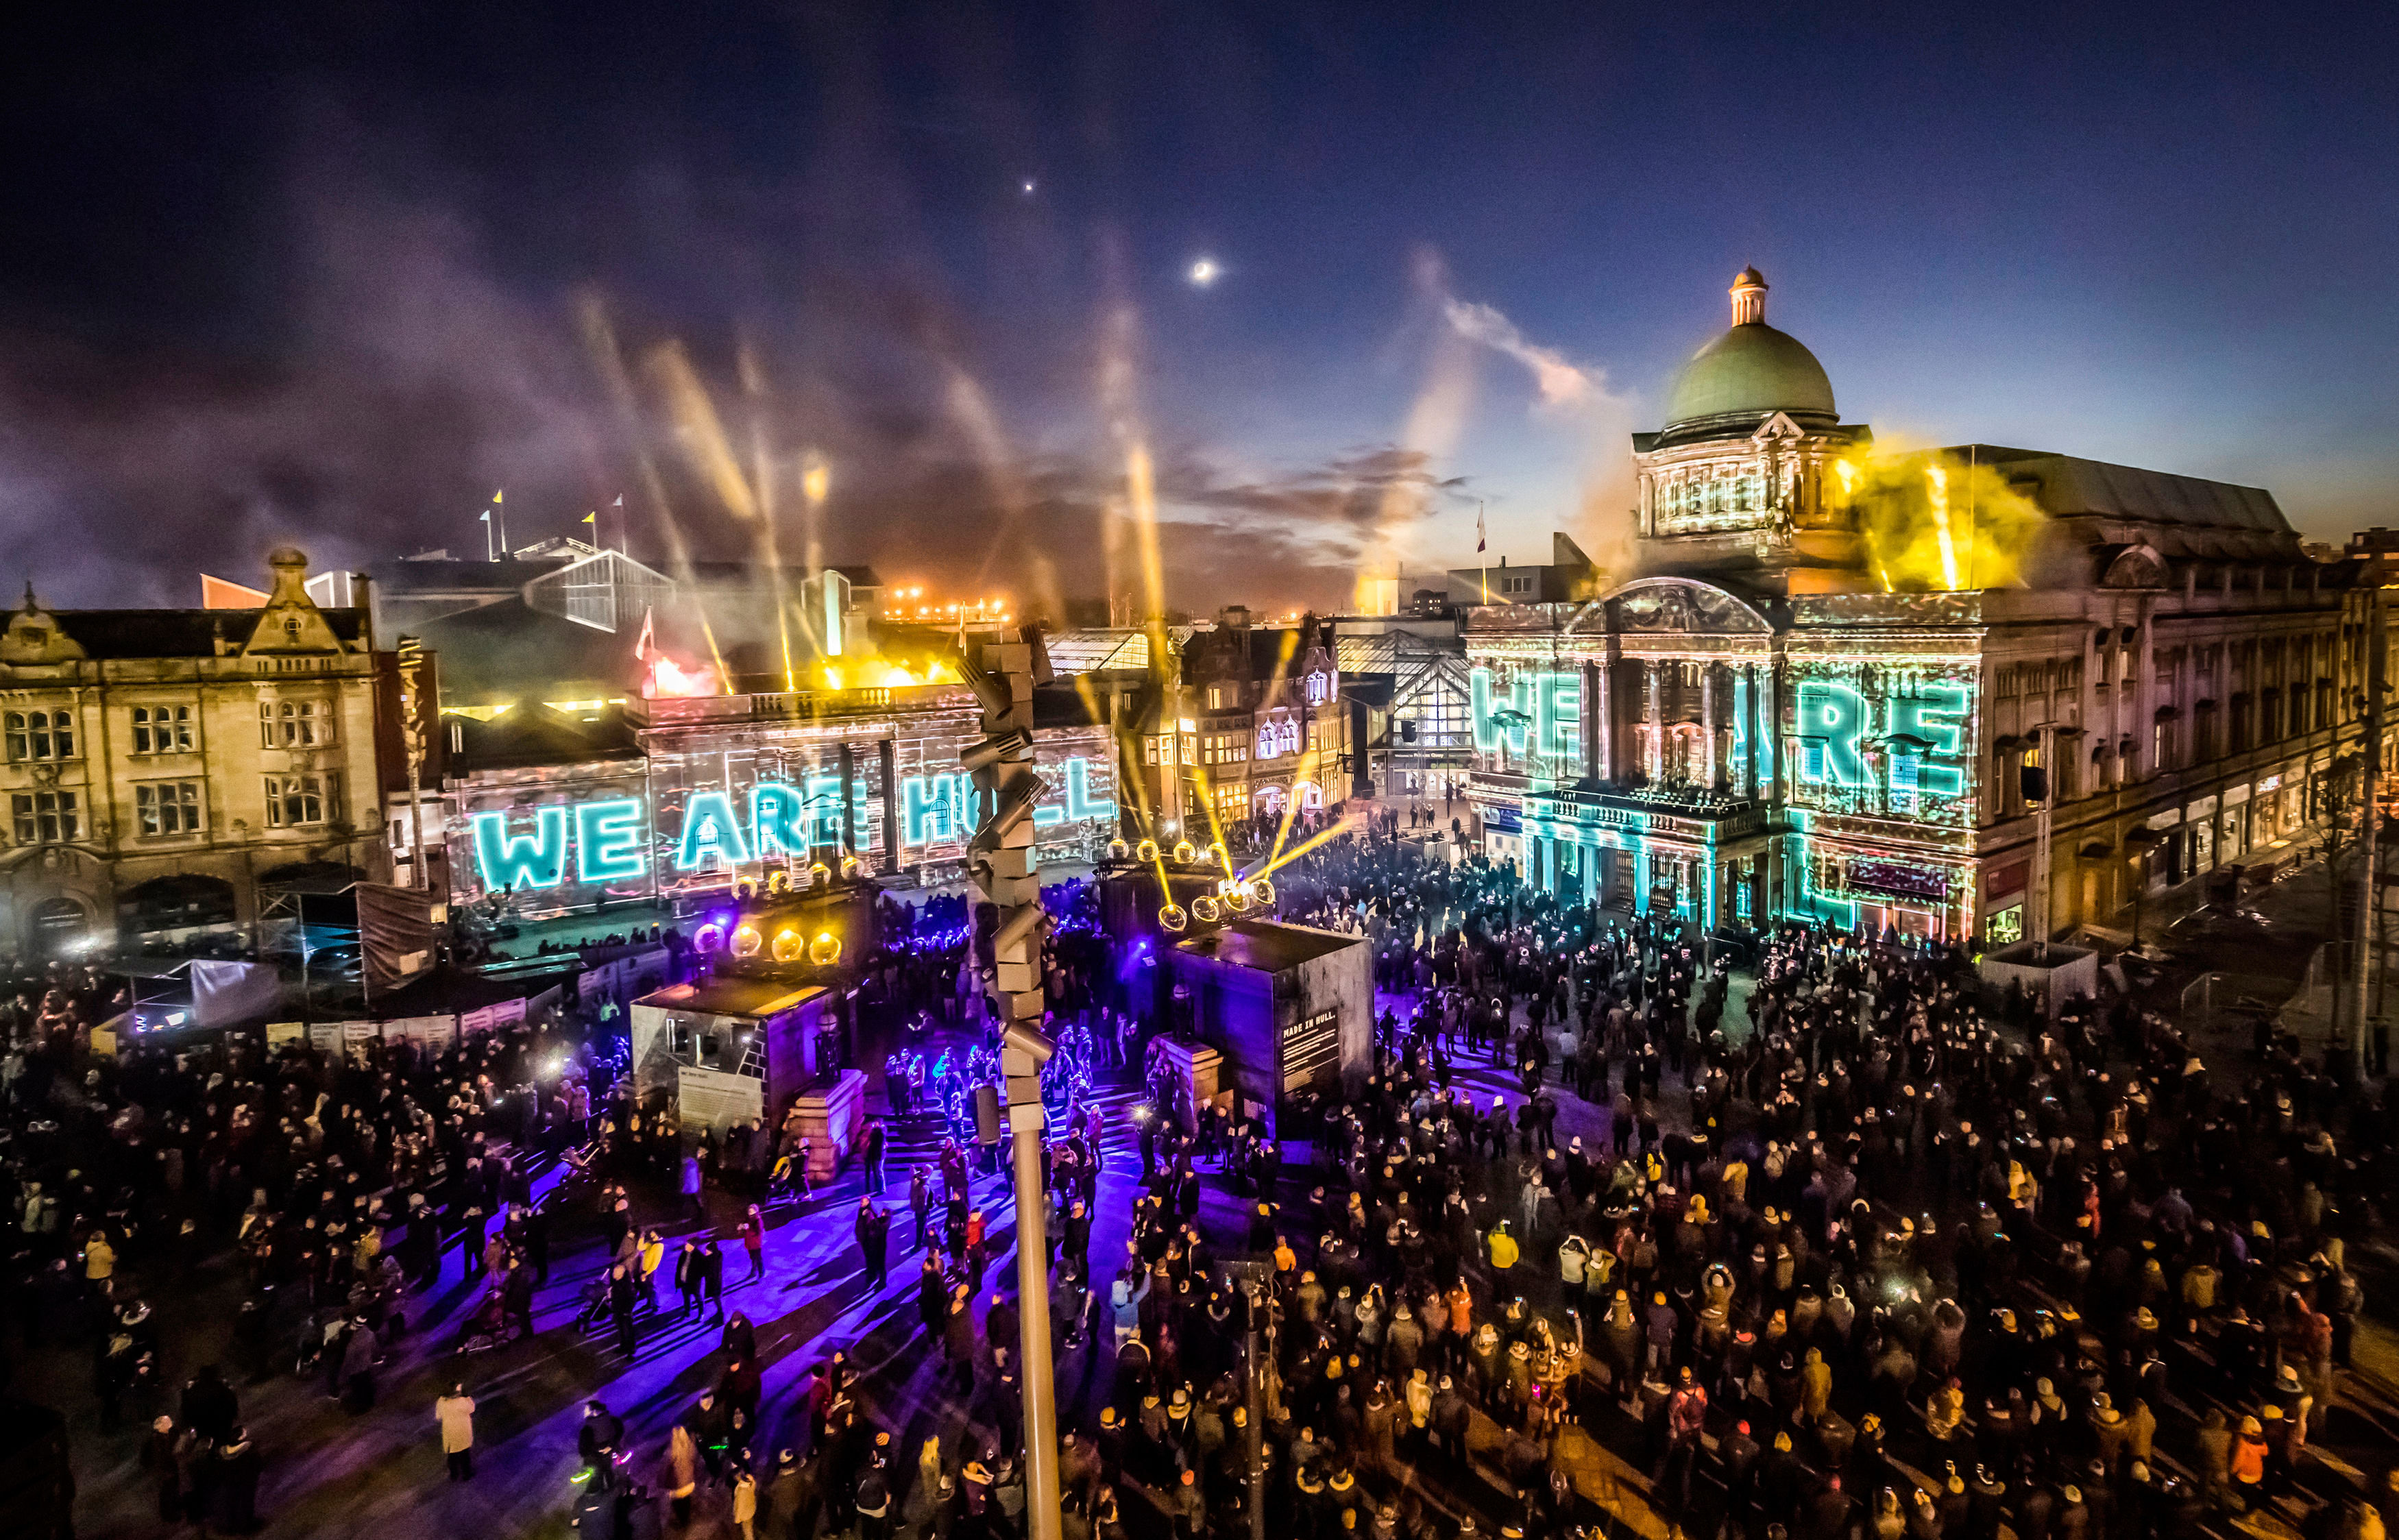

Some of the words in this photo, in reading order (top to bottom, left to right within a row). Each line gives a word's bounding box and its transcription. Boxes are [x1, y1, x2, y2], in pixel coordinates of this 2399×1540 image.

[1470, 667, 1580, 755] WE
[473, 798, 646, 892] WE
[675, 776, 870, 870] ARE
[1283, 1023, 1302, 1038] MADE
[1304, 1018, 1314, 1029] IN
[1315, 1011, 1335, 1025] HULL.
